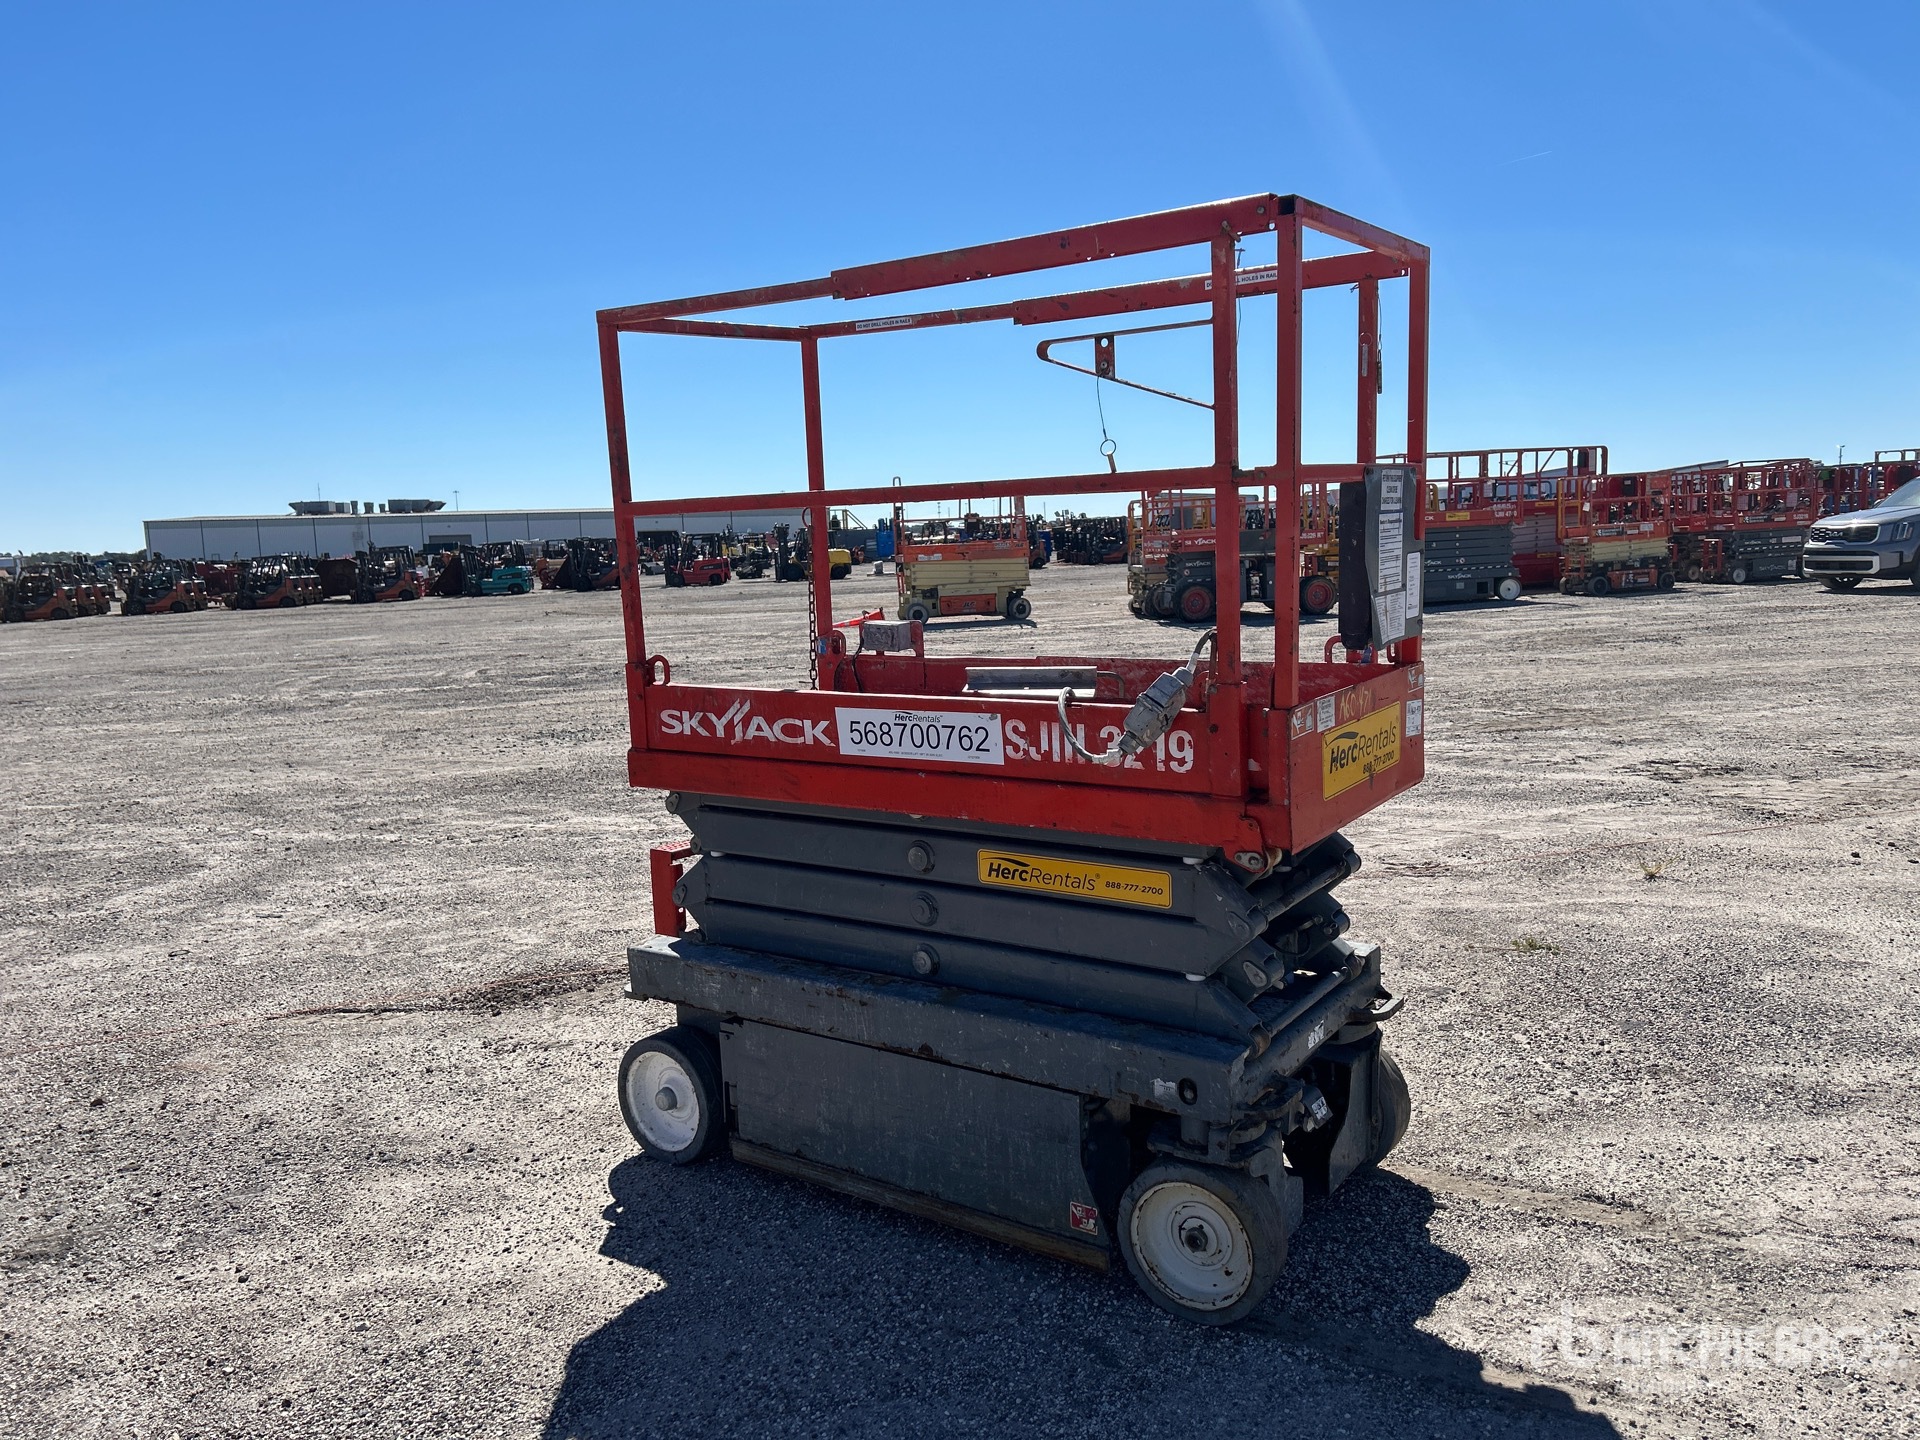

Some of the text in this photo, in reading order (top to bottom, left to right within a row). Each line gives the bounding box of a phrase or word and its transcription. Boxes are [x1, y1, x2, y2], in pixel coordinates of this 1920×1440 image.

[1241, 274, 1259, 282] HOLES
[661, 699, 836, 746] SKYJACK
[894, 713, 941, 723] HercRentals
[850, 720, 990, 753] 568700762
[1329, 720, 1396, 774] HercRentals
[987, 861, 1164, 896] HercRentals 888-777-2700
